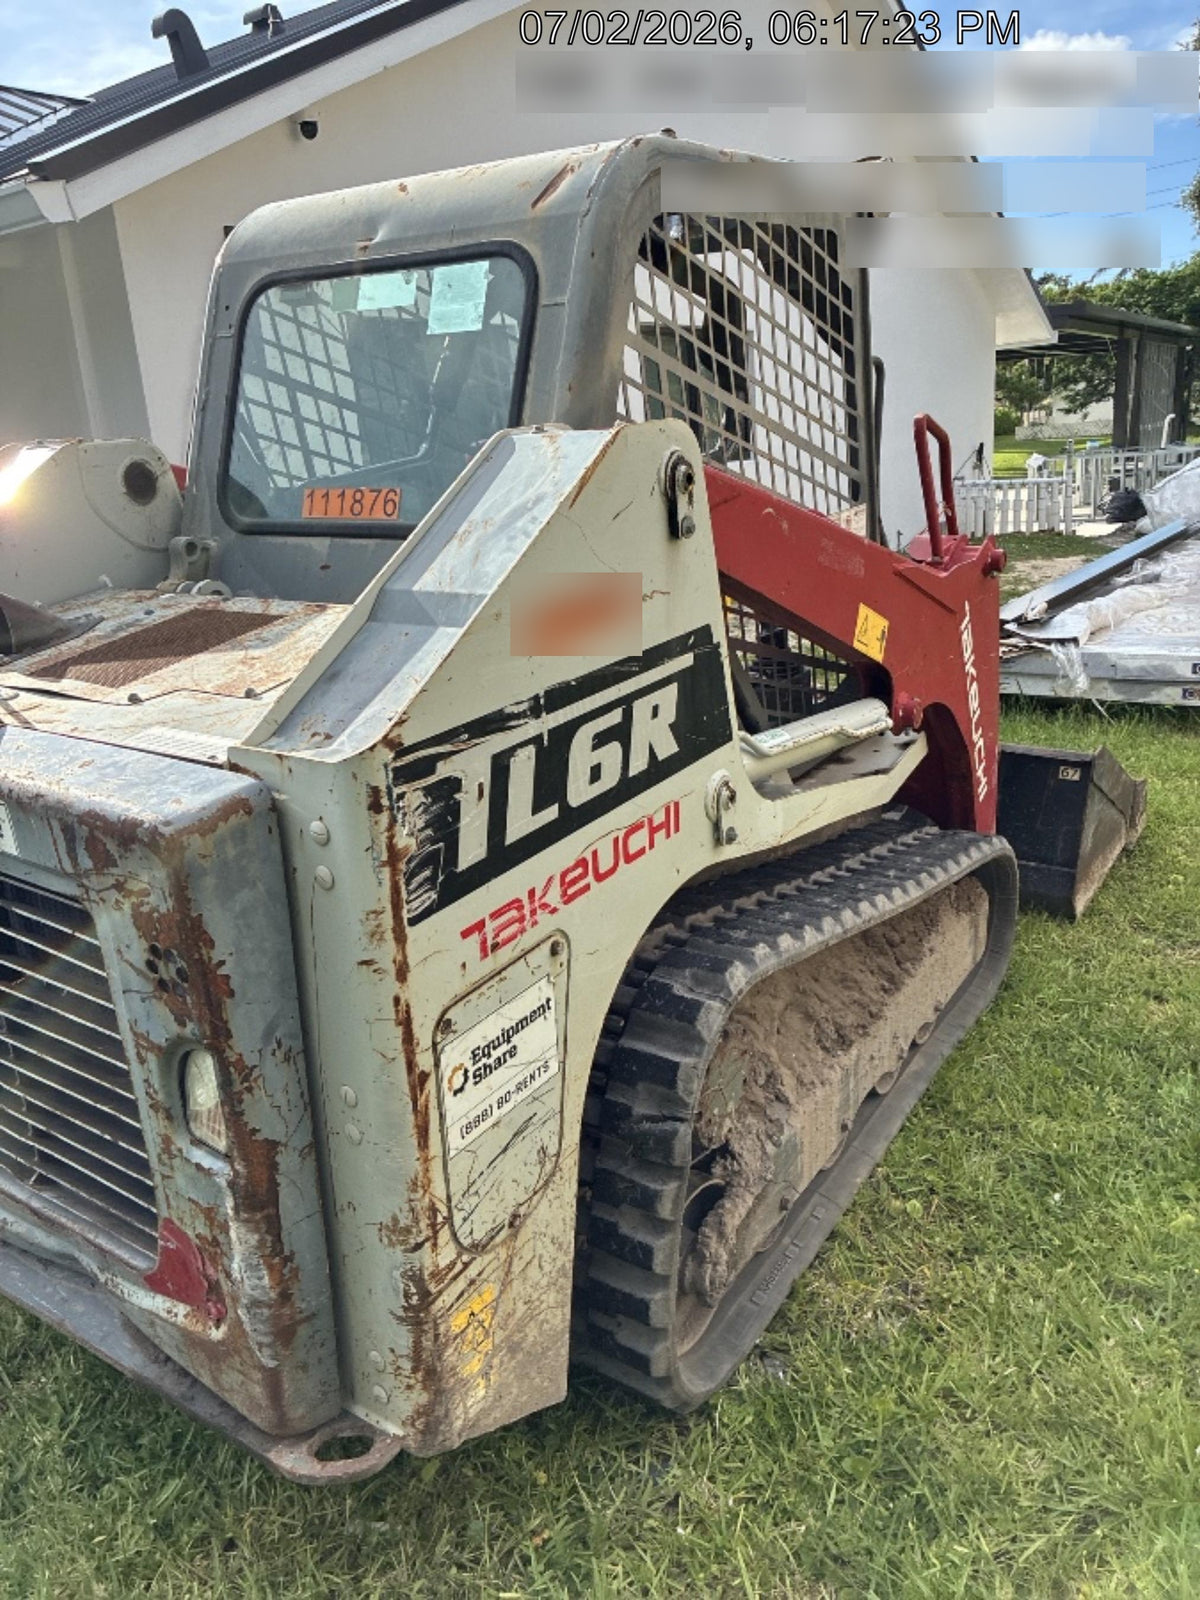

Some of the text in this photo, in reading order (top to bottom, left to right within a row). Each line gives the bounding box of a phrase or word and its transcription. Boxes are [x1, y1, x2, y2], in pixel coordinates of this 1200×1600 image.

[306, 488, 398, 517] 111876
[436, 681, 681, 874] TL6R
[470, 996, 552, 1066] Equipment
[472, 1043, 518, 1087] Share
[460, 1103, 494, 1140] (888)
